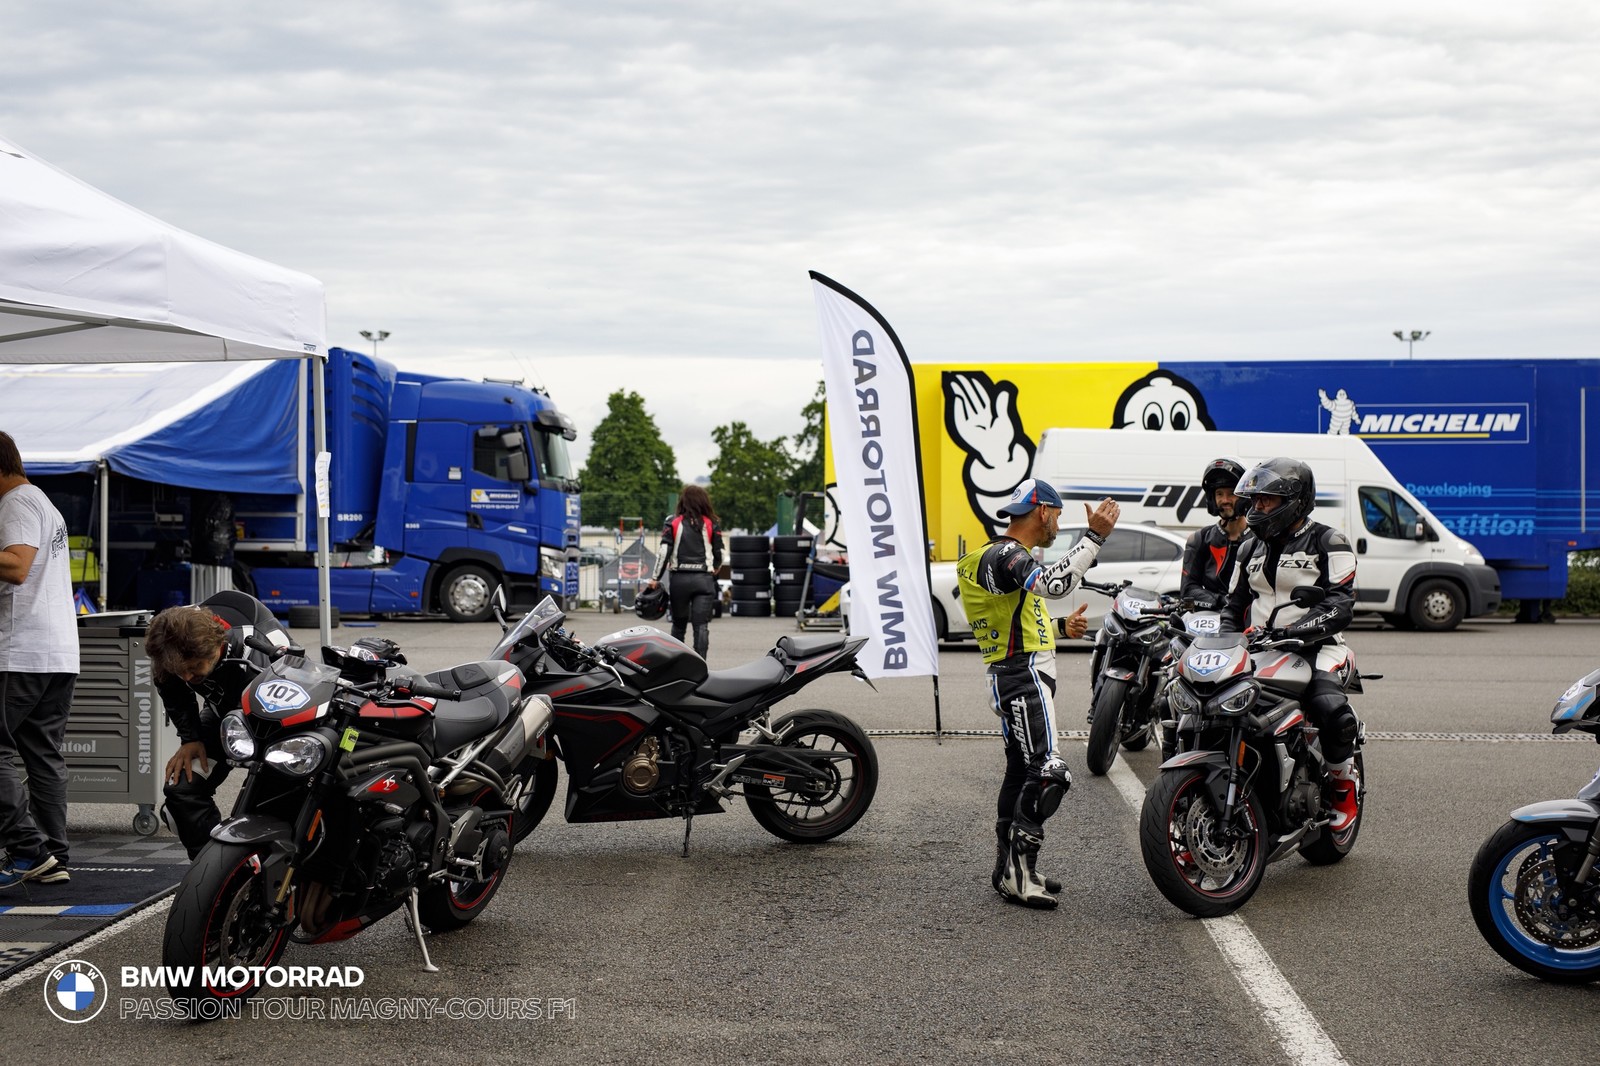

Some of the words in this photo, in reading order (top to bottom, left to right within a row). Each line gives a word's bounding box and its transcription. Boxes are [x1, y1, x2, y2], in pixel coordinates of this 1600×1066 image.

[1359, 413, 1521, 433] MICHELIN
[1405, 482, 1492, 498] Developing
[1143, 484, 1209, 524] ap
[337, 513, 363, 522] SR200
[1441, 513, 1535, 536] etition
[1033, 597, 1049, 647] TRACK
[1193, 619, 1216, 629] 125
[1194, 653, 1222, 666] 111
[266, 683, 300, 703] 107
[134, 692, 151, 774] samtool
